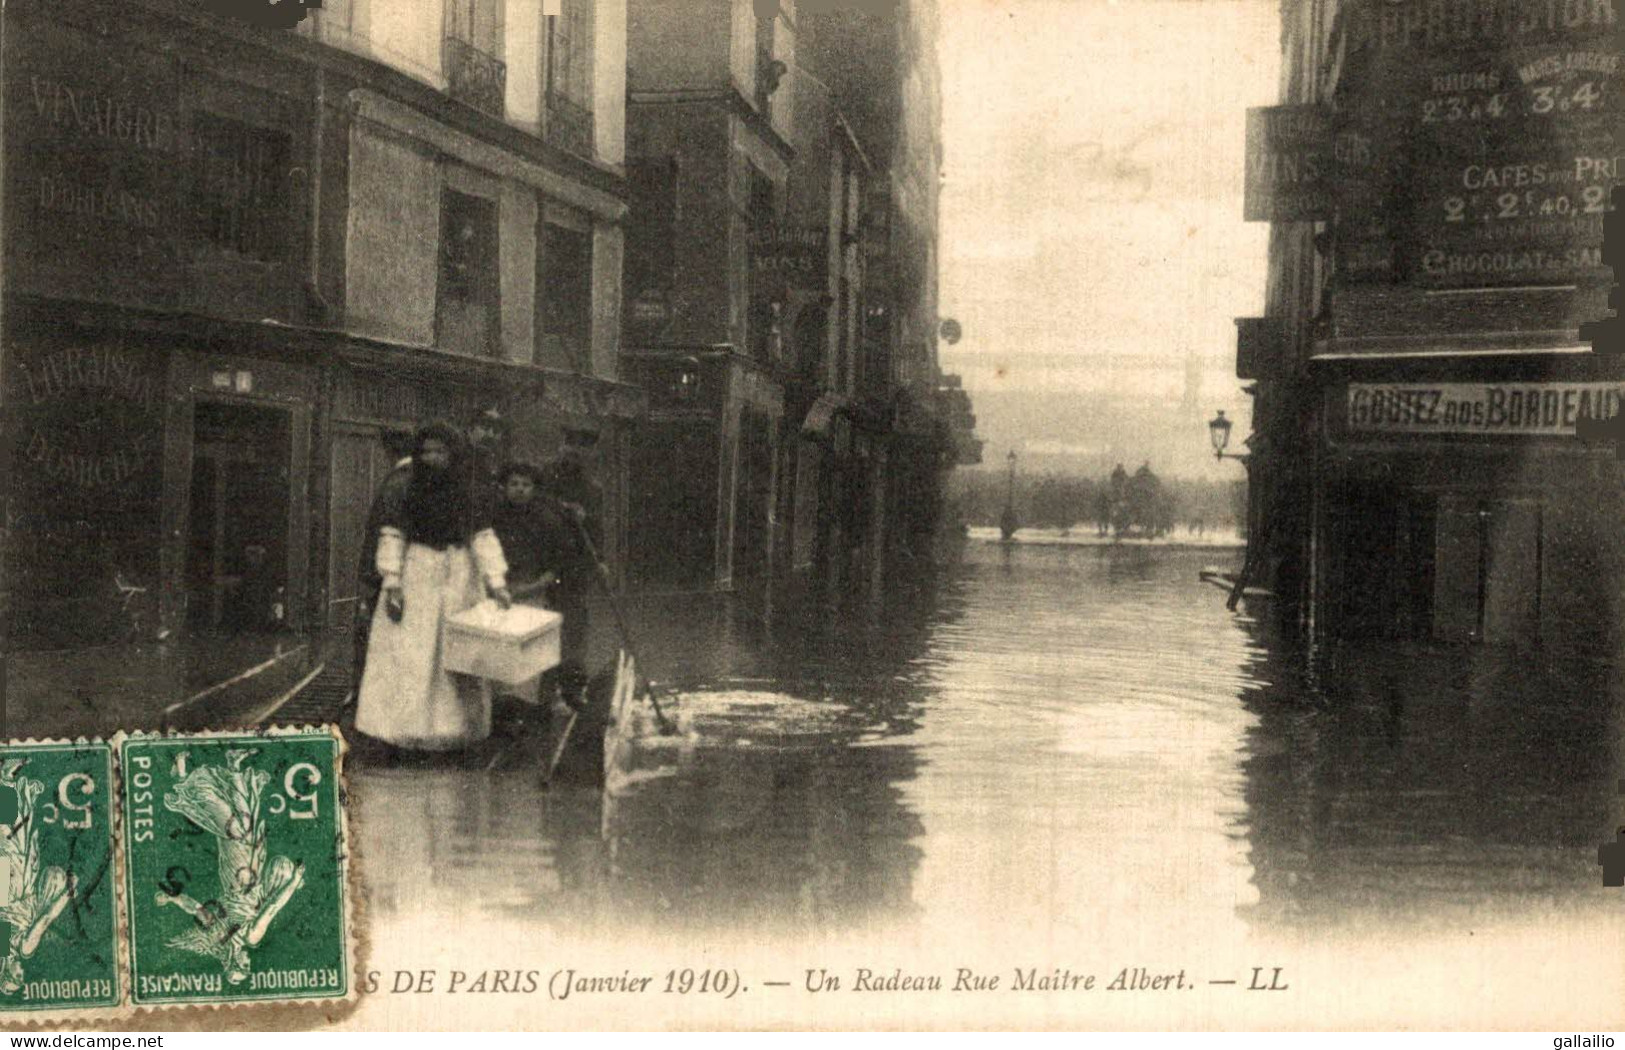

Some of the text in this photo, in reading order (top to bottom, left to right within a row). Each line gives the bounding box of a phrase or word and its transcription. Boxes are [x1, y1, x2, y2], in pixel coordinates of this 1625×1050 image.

[132, 755, 154, 843] POSTES
[390, 970, 437, 994] DE
[447, 969, 540, 994] PARIS
[548, 969, 653, 1000] (Janvier
[663, 968, 749, 999] 1910).
[804, 968, 841, 993] Un
[852, 968, 943, 992] Radeau
[951, 968, 1000, 992] Rue
[1106, 968, 1195, 991] Albert.
[1247, 967, 1289, 991] LL
